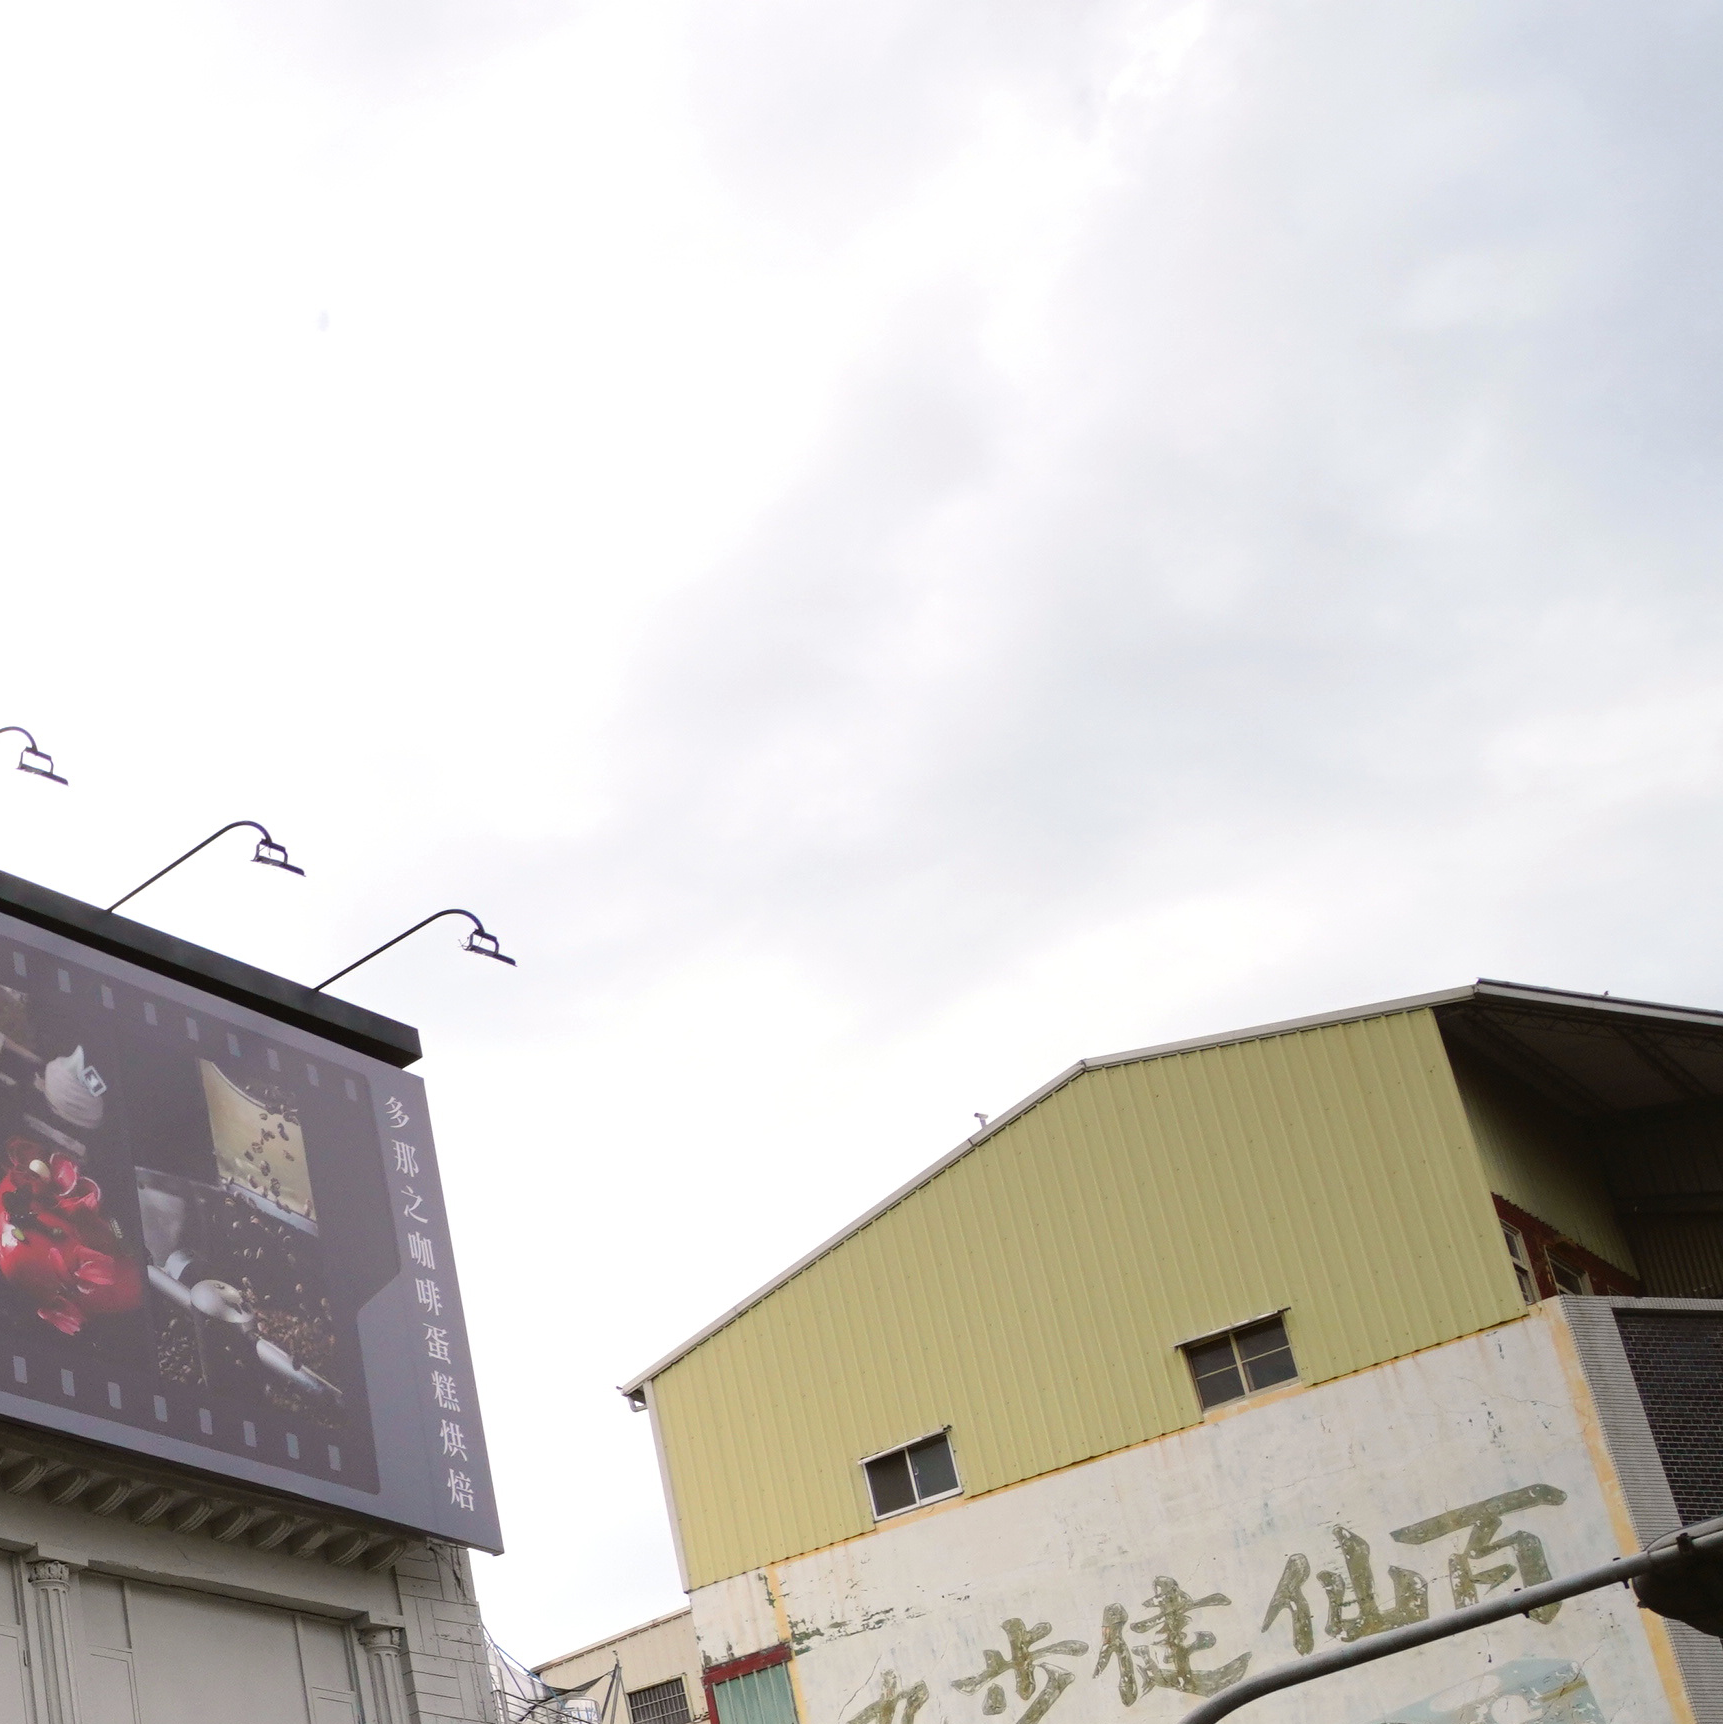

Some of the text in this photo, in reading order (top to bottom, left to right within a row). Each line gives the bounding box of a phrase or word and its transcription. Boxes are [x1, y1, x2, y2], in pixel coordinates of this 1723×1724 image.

[384, 1095, 475, 1513] 多那之咖啡蛋糕烘焙
